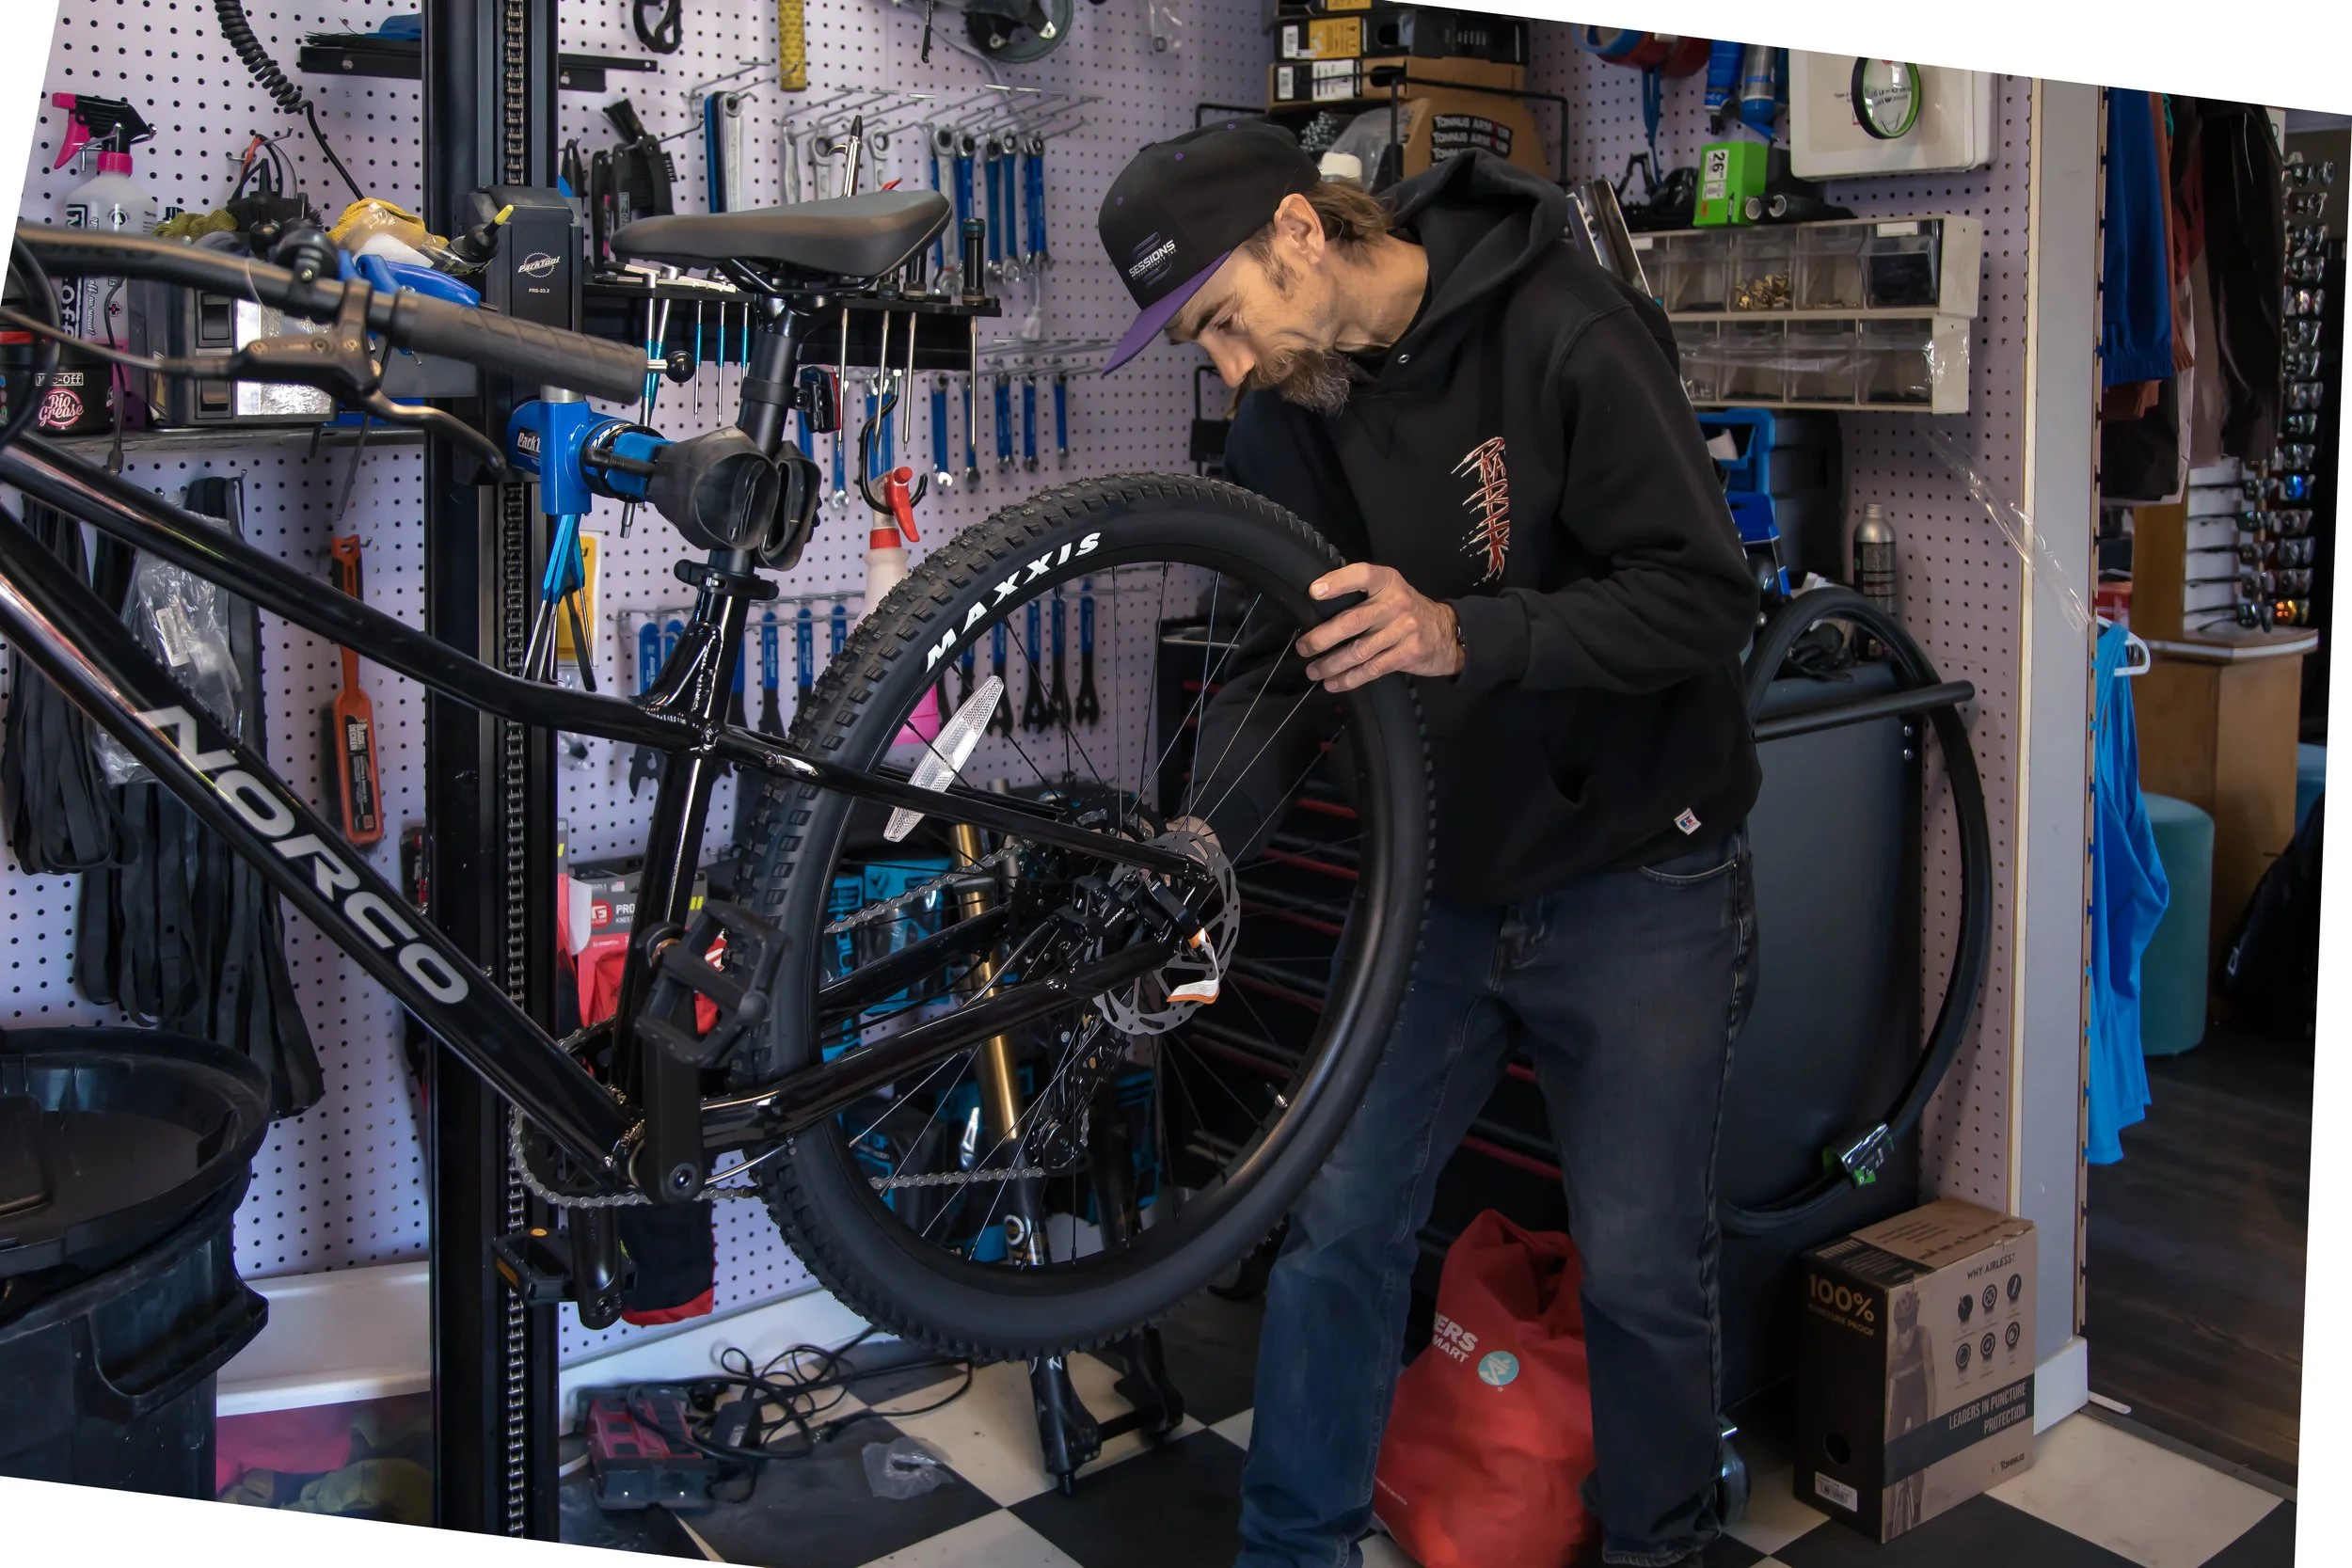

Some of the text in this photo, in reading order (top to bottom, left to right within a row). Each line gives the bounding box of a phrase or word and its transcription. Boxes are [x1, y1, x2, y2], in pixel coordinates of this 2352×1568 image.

[1129, 239, 1176, 277] SESSIONS
[39, 404, 85, 428] Grease
[48, 393, 72, 410] Bio
[926, 532, 1102, 673] MAXXIS
[134, 705, 469, 1005] NORCO
[1966, 1252, 2016, 1280] WHY AIRLESS?
[1808, 1274, 1875, 1323] 100%
[1948, 1382, 2027, 1430] LEADERS IN PUNCTURE
[1983, 1402, 2026, 1434] PROTECTION
